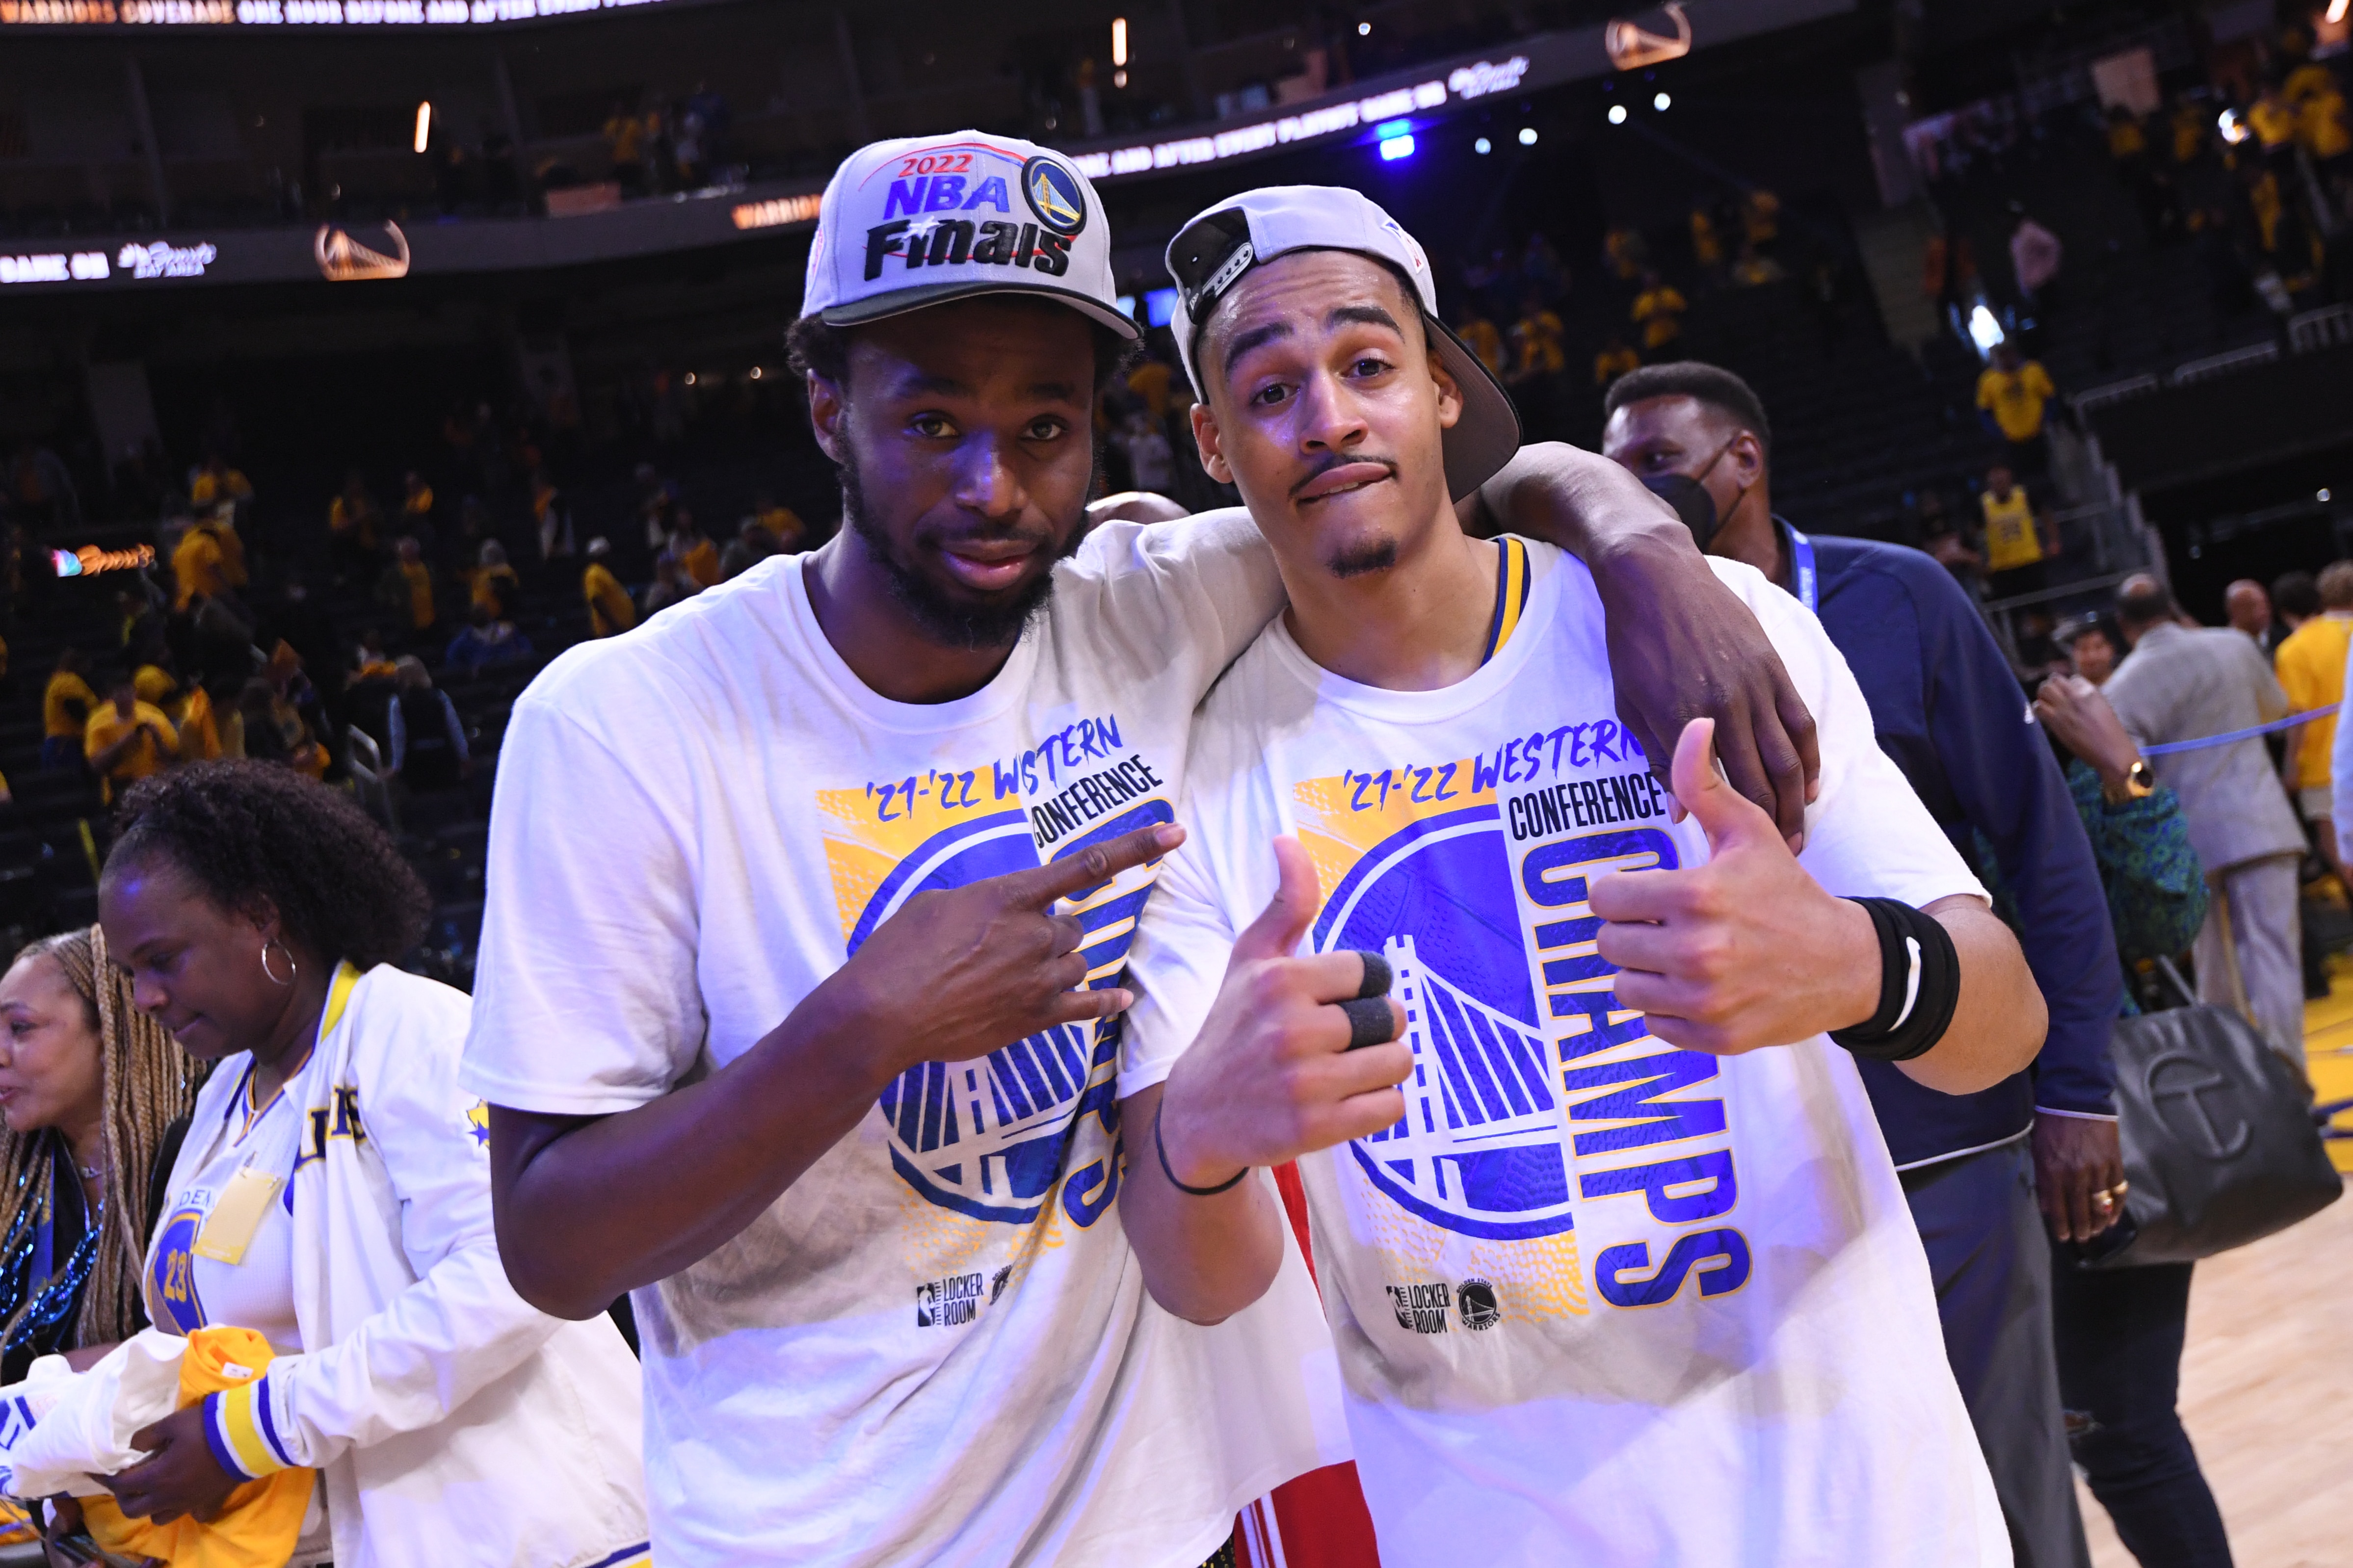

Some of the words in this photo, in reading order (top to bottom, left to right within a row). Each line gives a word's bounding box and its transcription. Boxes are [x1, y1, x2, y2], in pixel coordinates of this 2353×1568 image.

[899, 154, 973, 178] 2022
[883, 175, 1010, 220] NBA
[864, 216, 1072, 281] Finals
[867, 769, 981, 822] '21-'22
[993, 713, 1123, 800] WSTERN
[1344, 764, 1458, 812] '21-'22
[1508, 772, 1667, 841] CONFERENCE
[943, 1272, 984, 1302] LOCKER
[1407, 1282, 1451, 1309] LOCKER
[1456, 1278, 1475, 1294] GOLDEN
[1477, 1278, 1493, 1289] STATE
[944, 1298, 976, 1327] ROOM
[1412, 1308, 1448, 1334] ROOM
[1462, 1312, 1501, 1331] WARRIORS
